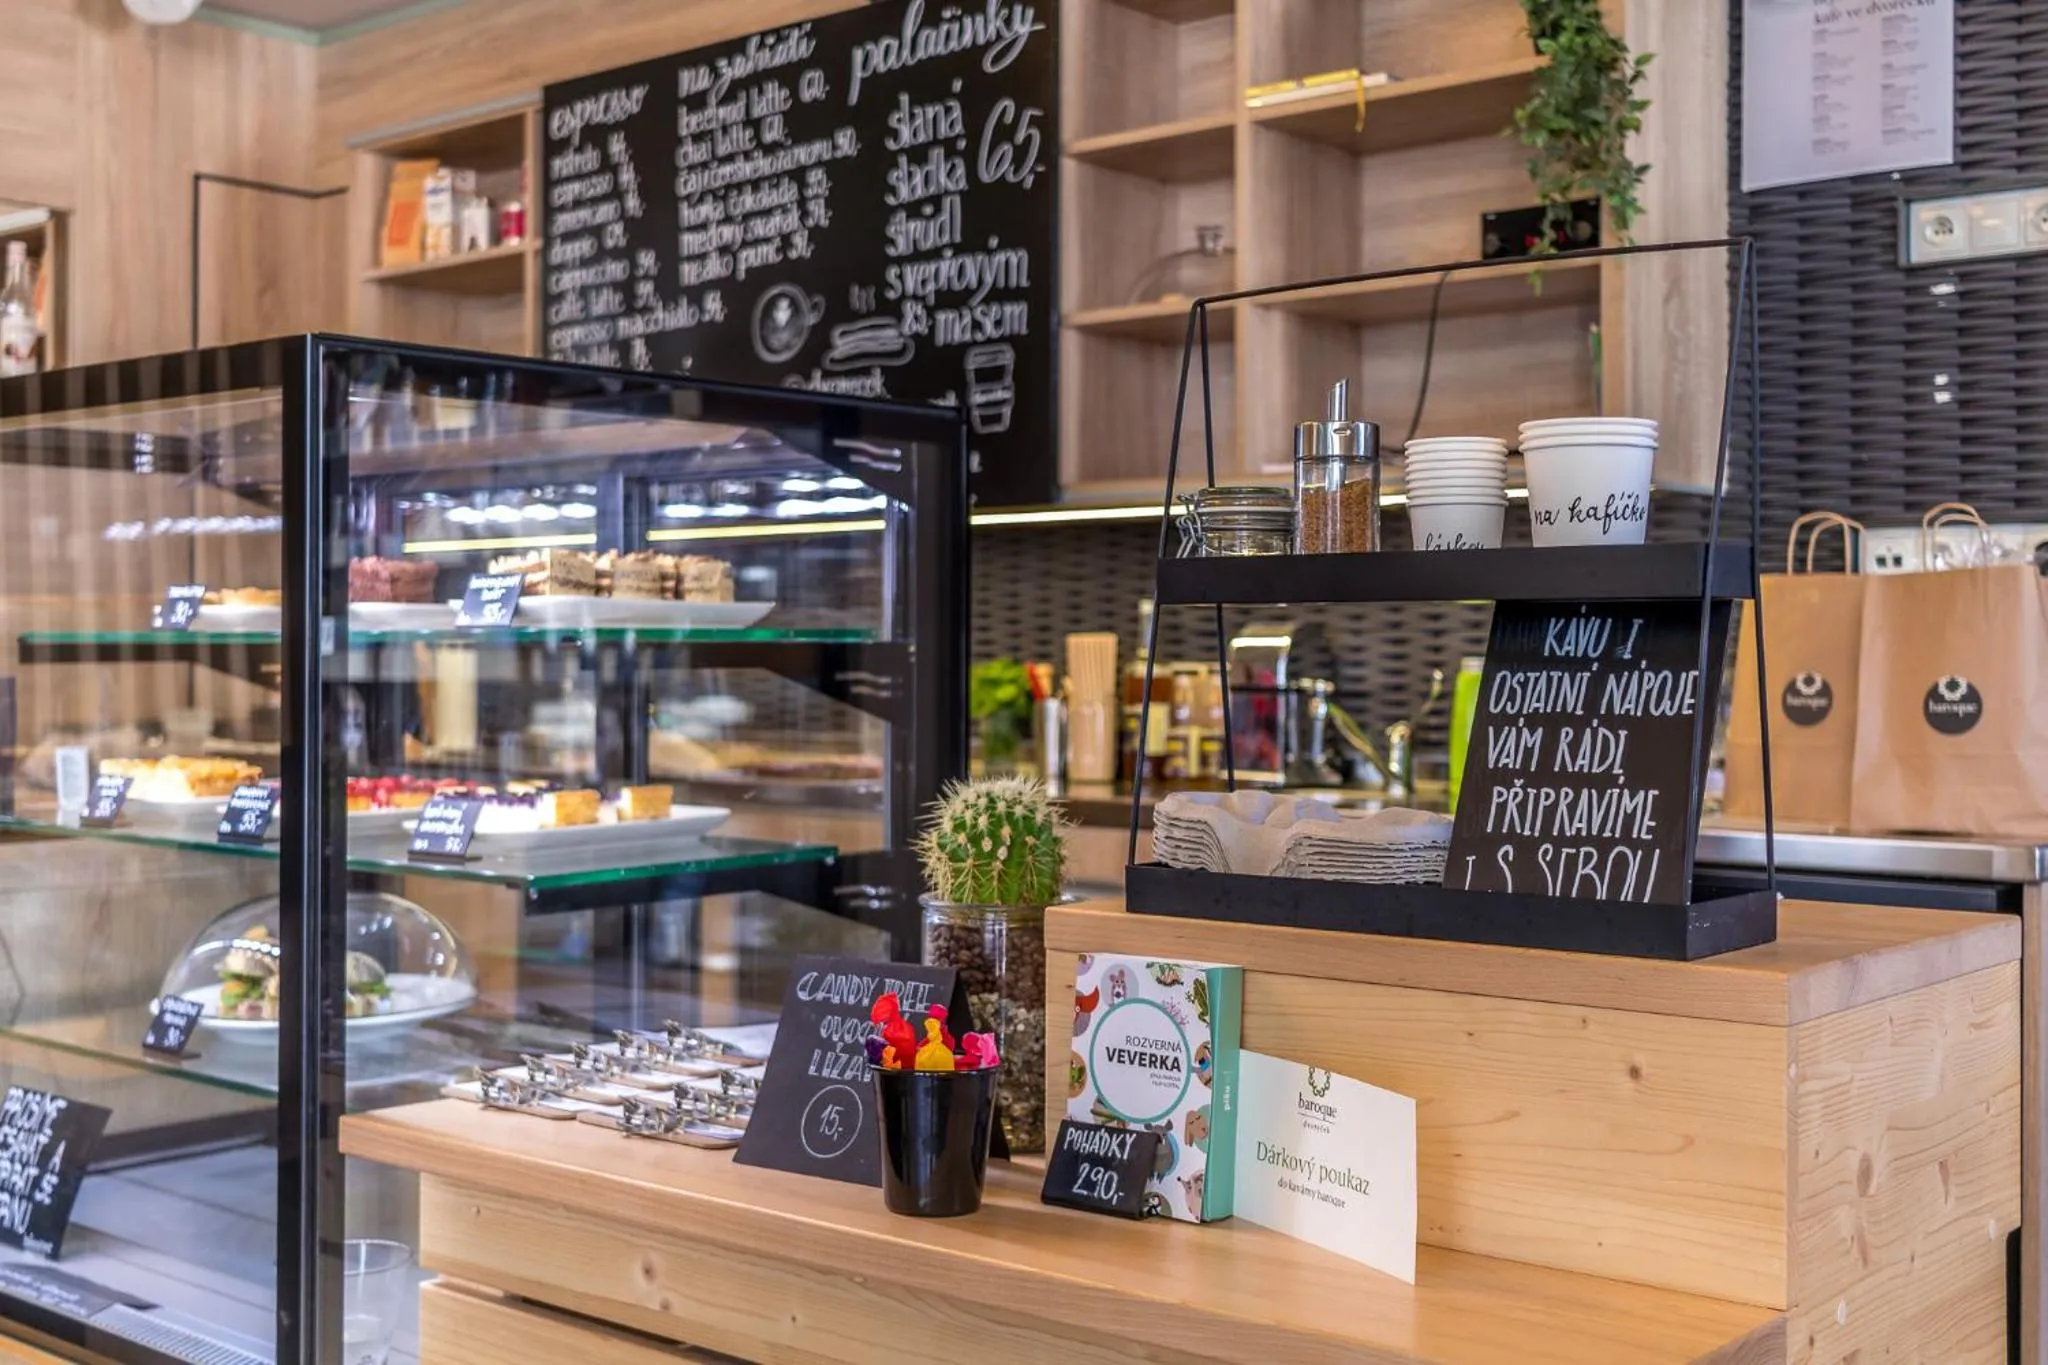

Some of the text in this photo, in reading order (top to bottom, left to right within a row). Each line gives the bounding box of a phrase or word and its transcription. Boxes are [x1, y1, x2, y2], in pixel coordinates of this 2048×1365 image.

[848, 0, 1046, 106] palačinky
[549, 84, 650, 147] espresso
[749, 79, 793, 119] latte
[885, 78, 966, 151] slaná
[713, 122, 756, 157] latte
[933, 300, 1032, 347] masem
[1534, 508, 1561, 526] na
[1544, 604, 1612, 657] KÁVU
[1488, 658, 1700, 717] OSTATNÍ NÁPOJE
[1487, 716, 1629, 775] VÁM RÁDI
[1485, 775, 1661, 840] PŘIPRAVÍME
[796, 971, 880, 1007] CANDY
[1105, 1045, 1183, 1074] VEVERKA
[1125, 1034, 1184, 1054] ROZVERNÁ
[819, 1103, 845, 1142] 15,-
[1298, 1091, 1338, 1120] baroque
[1063, 1126, 1138, 1162] POHÁDKY
[1072, 1161, 1126, 1207] 290,-
[1256, 1140, 1372, 1197] Dárkový poukaz
